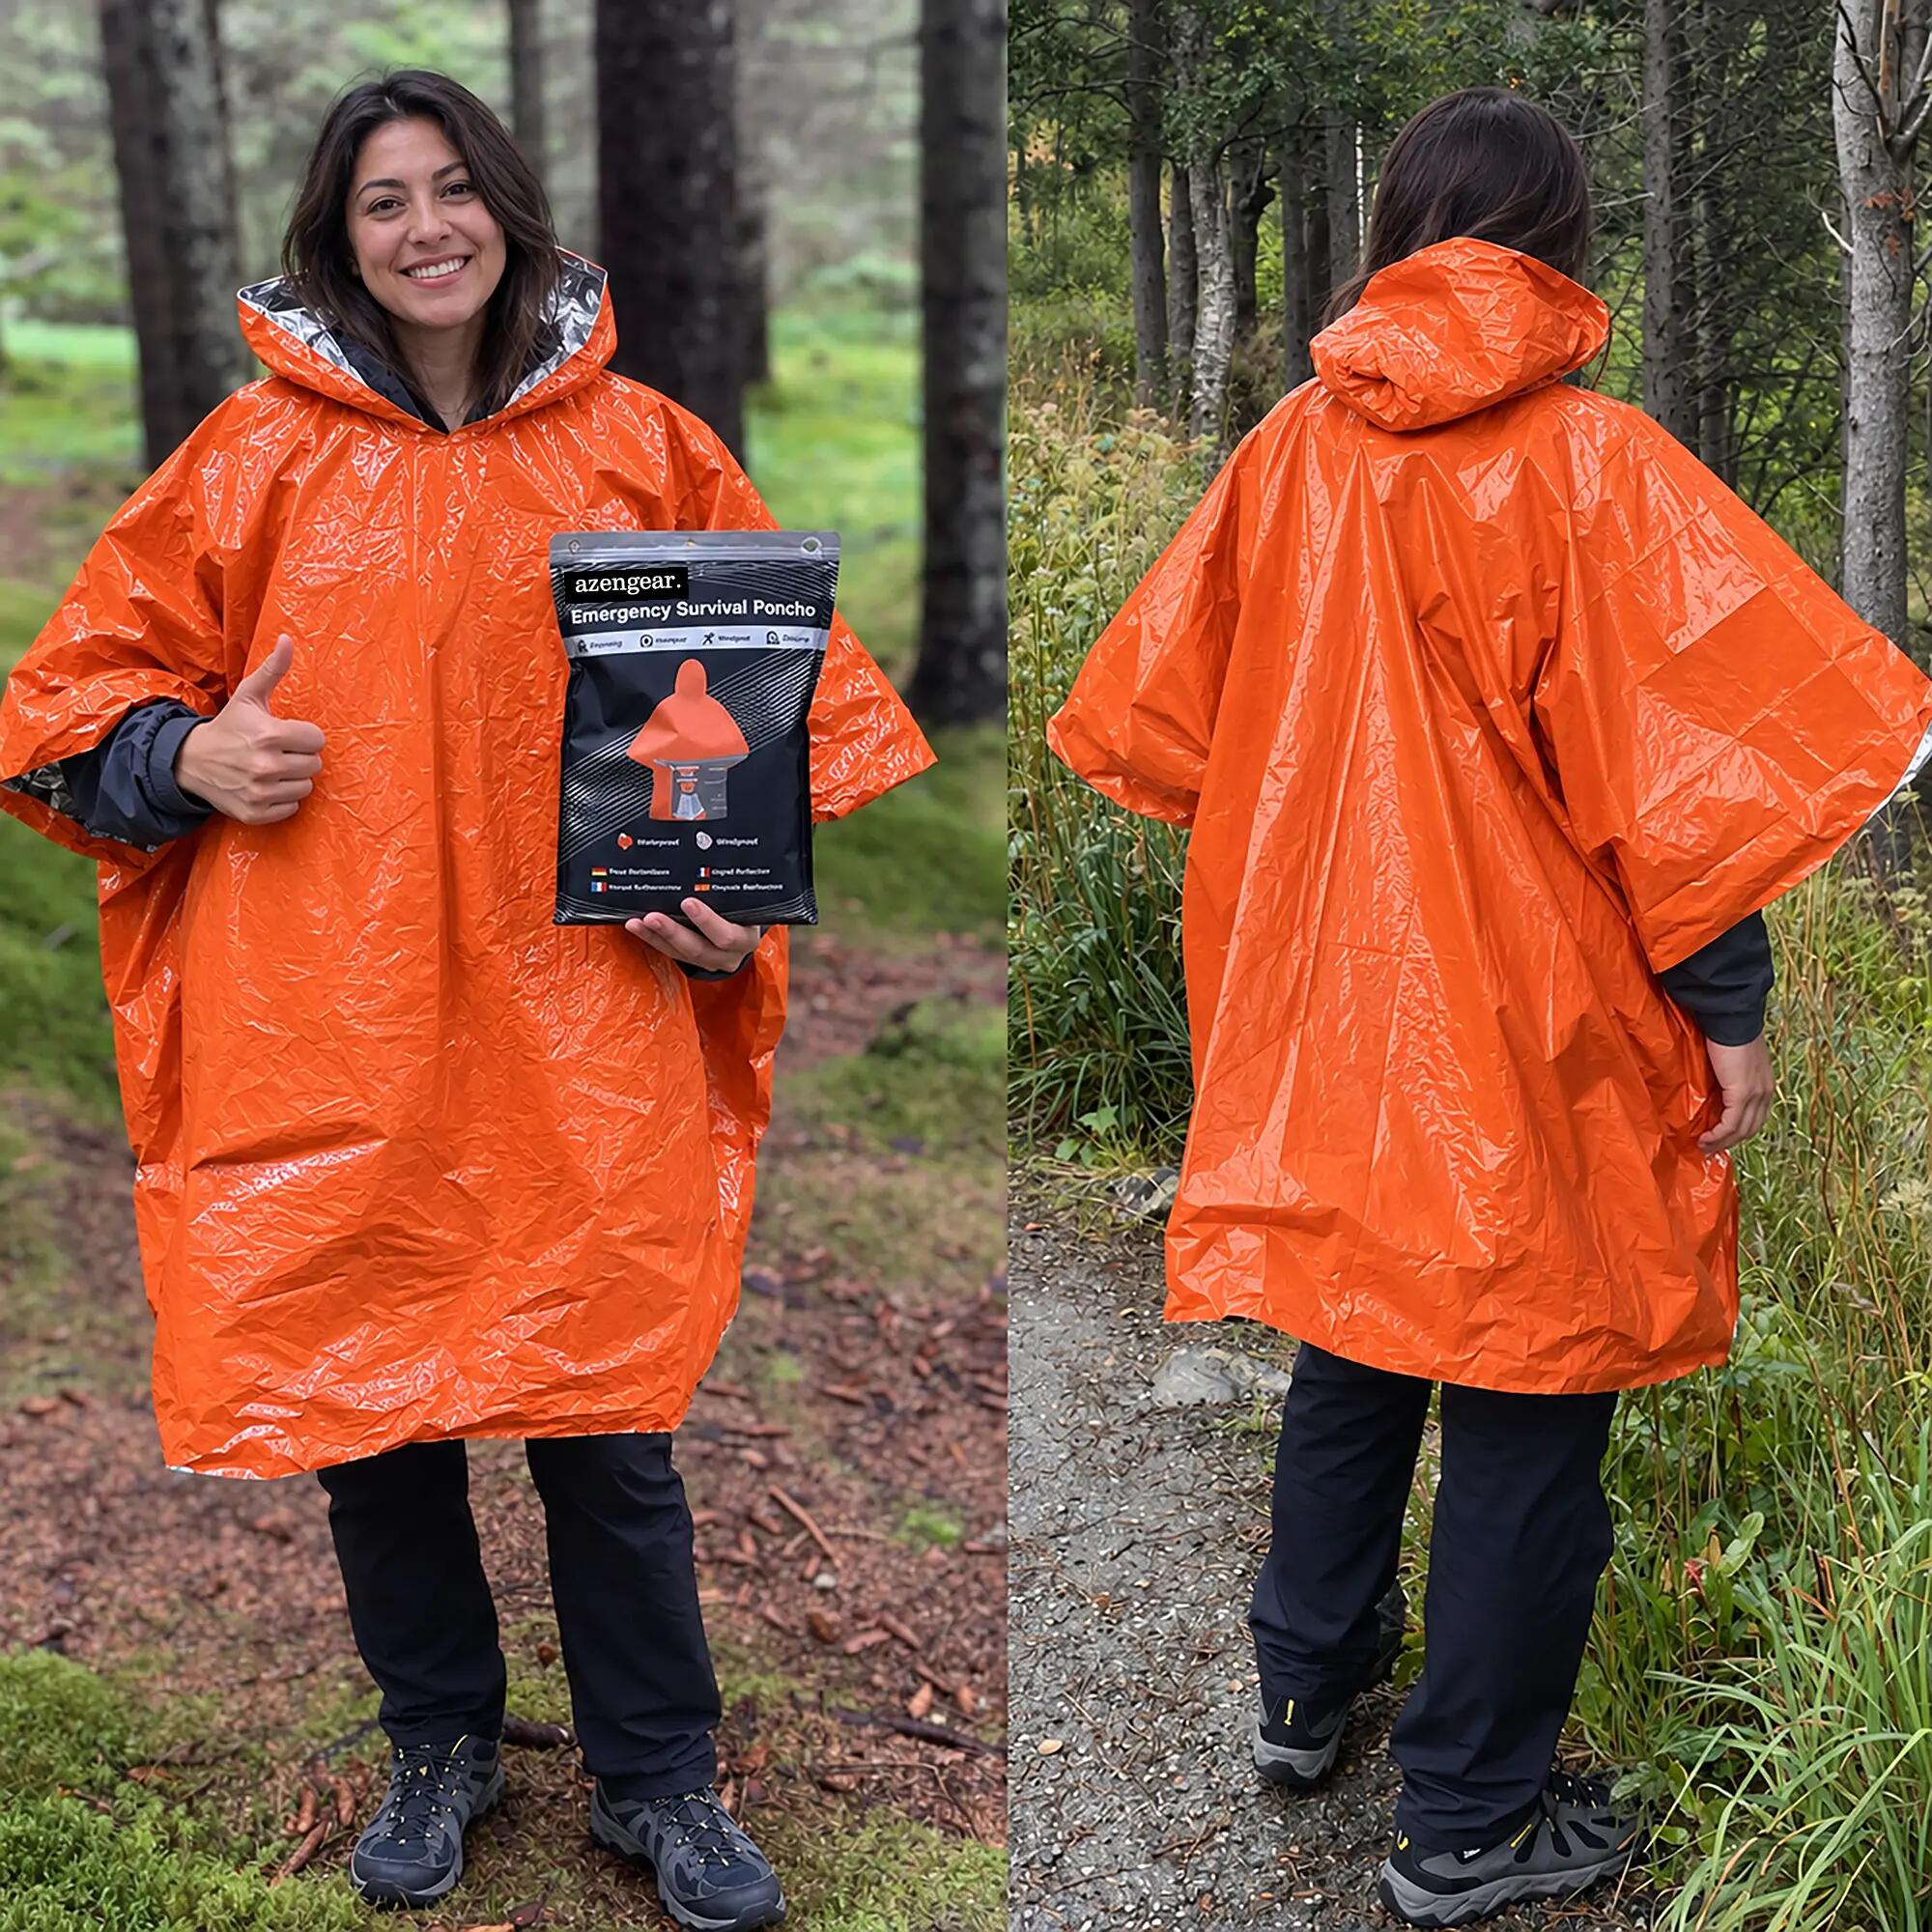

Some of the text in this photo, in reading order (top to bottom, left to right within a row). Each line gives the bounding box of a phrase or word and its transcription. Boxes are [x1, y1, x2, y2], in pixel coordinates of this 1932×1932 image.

[575, 575, 681, 595] azengear.
[571, 599, 816, 624] Emergency Survival Poncho
